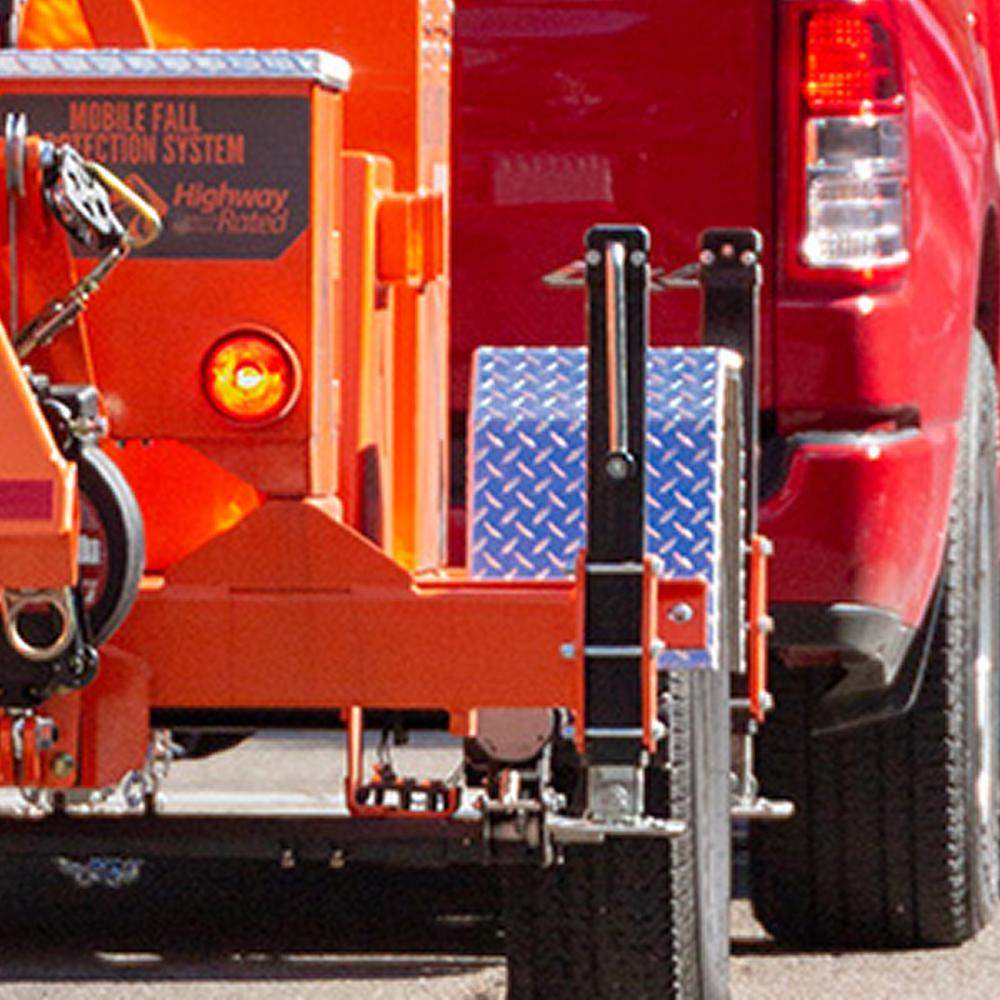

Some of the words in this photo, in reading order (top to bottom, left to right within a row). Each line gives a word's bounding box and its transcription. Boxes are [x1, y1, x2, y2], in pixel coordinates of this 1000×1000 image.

[68, 101, 146, 132] MOBILE
[151, 101, 201, 133] FALL
[162, 133, 245, 166] SYSTEM
[172, 181, 289, 215] Highway
[216, 209, 289, 235] Rated
